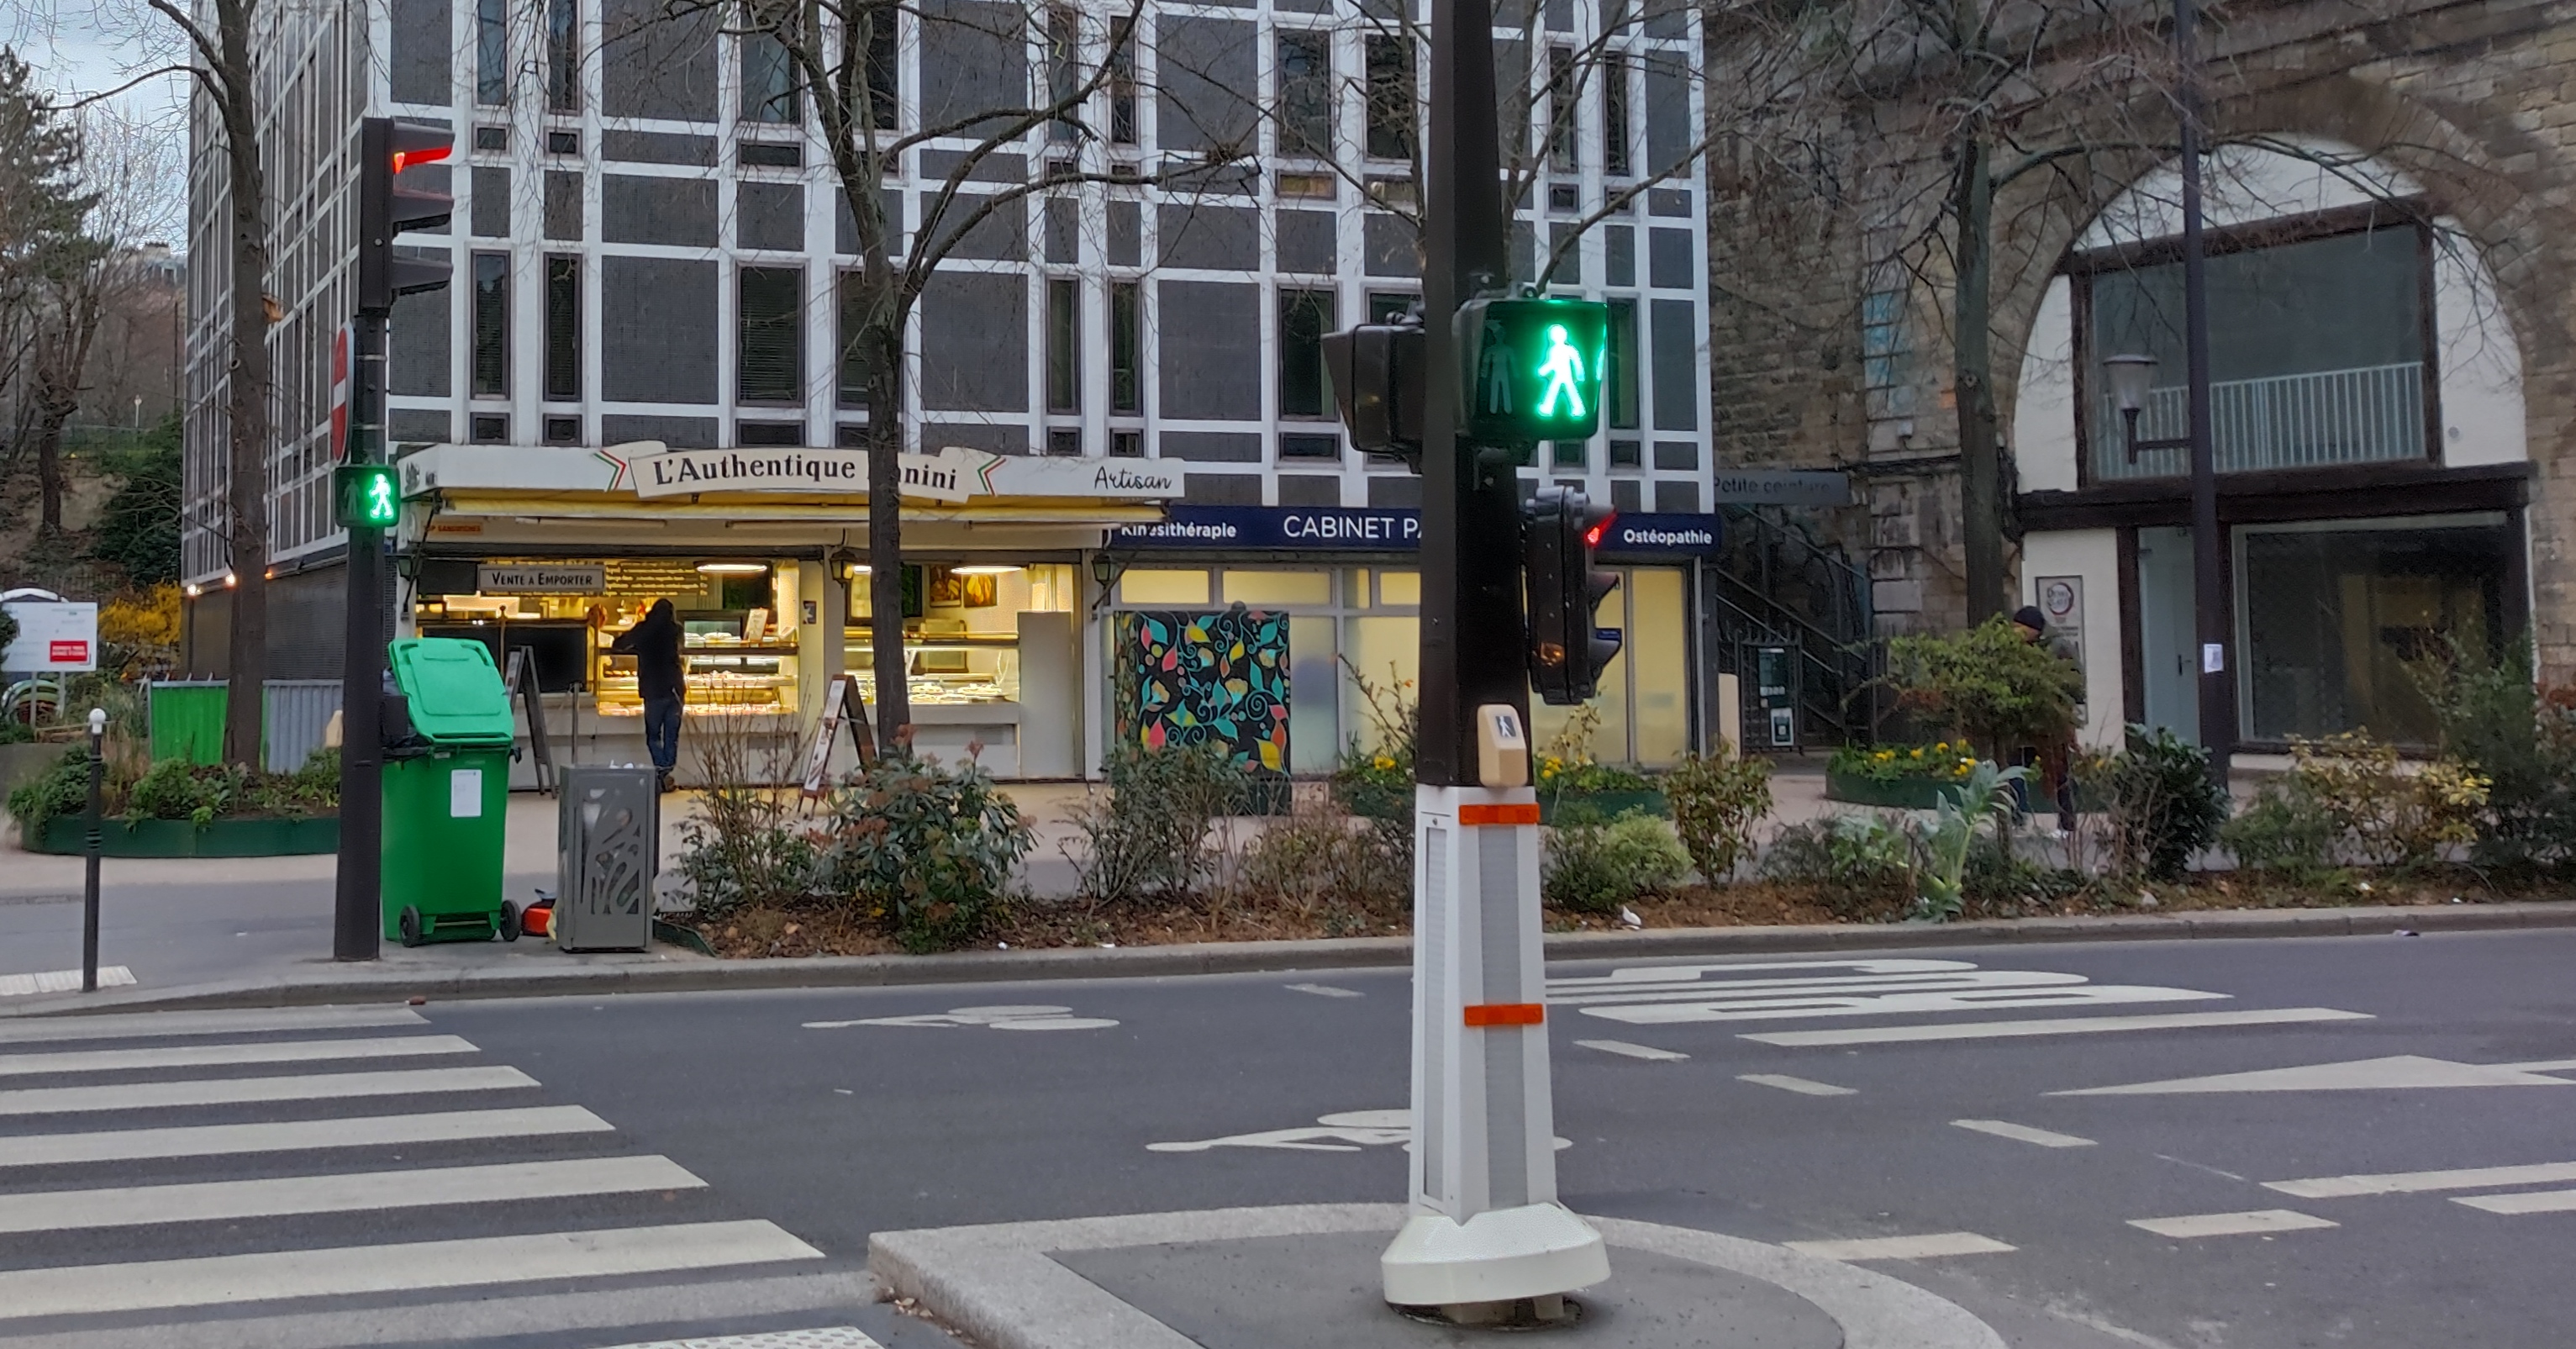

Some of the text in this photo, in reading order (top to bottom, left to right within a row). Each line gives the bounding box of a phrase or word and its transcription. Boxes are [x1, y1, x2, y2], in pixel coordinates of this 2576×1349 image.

[653, 453, 956, 492] L'Authentique nini
[1094, 465, 1172, 491] Artisan
[1283, 515, 1395, 539] CABINET
[1623, 528, 1713, 545] Ostéopathie
